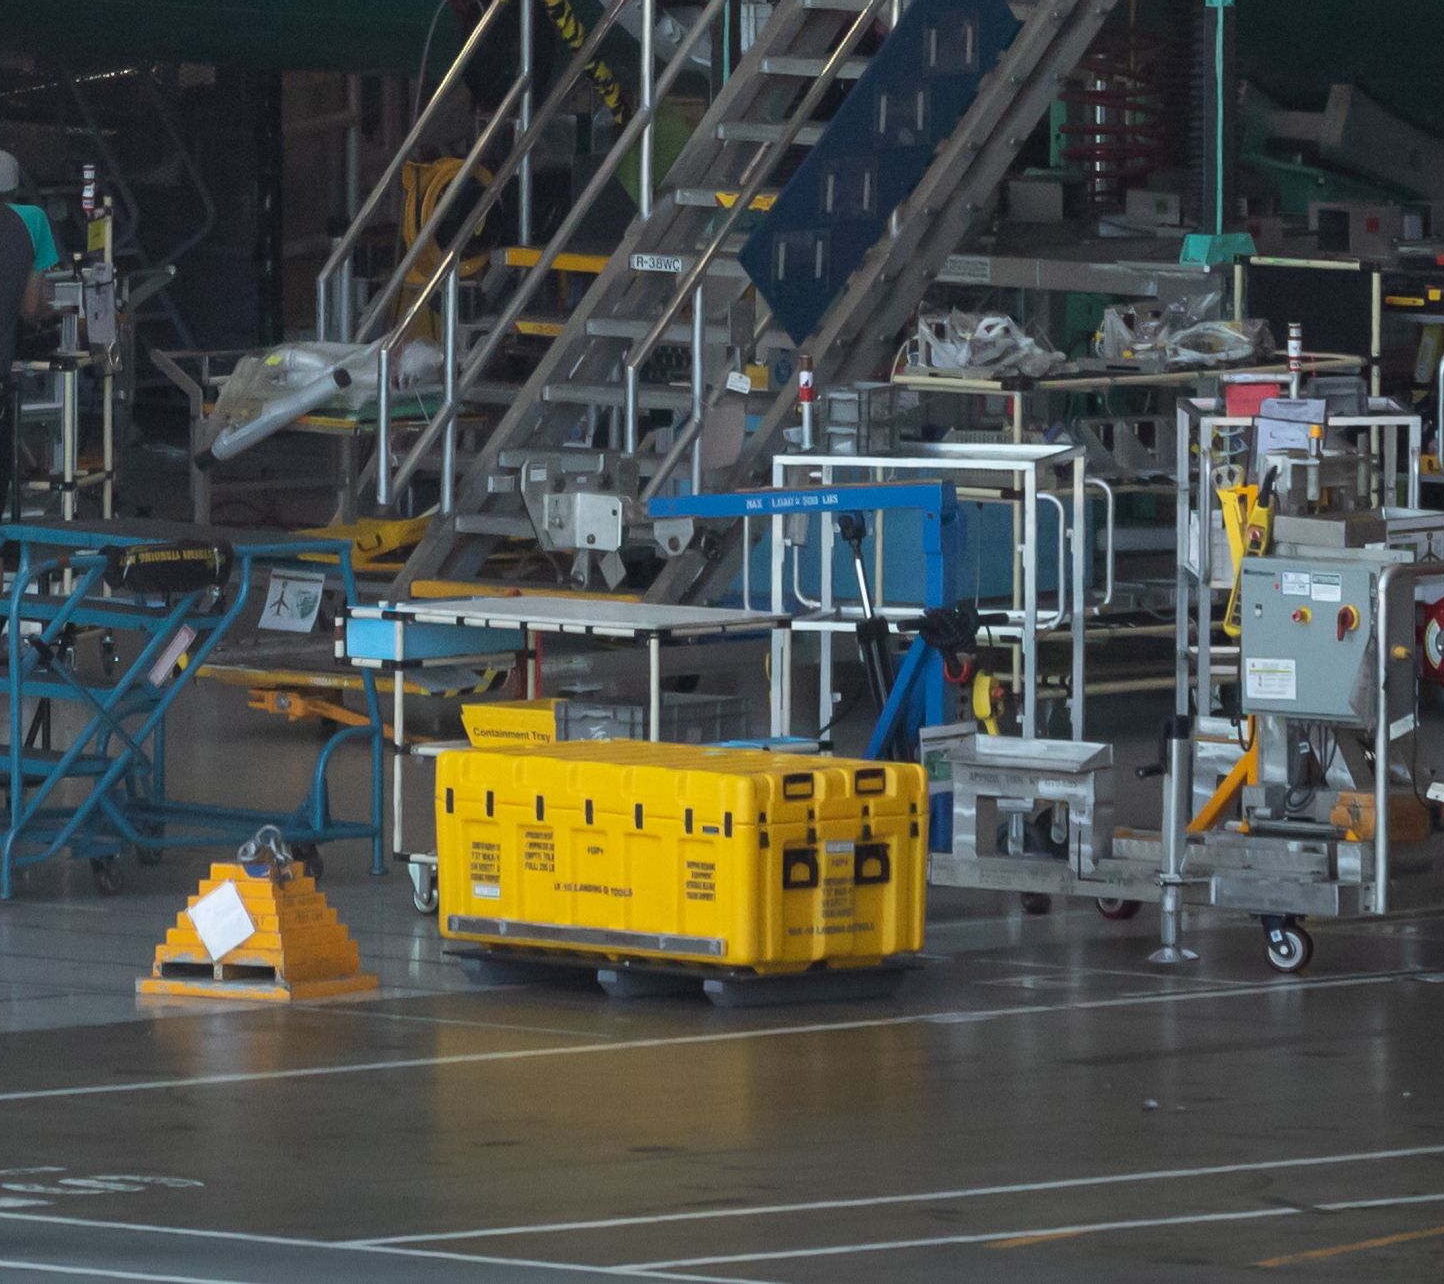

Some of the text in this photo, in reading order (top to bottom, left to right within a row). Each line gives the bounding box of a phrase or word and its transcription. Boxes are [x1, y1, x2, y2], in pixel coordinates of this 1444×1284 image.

[635, 255, 680, 271] R-38WC
[473, 728, 551, 743] Containment Tray
